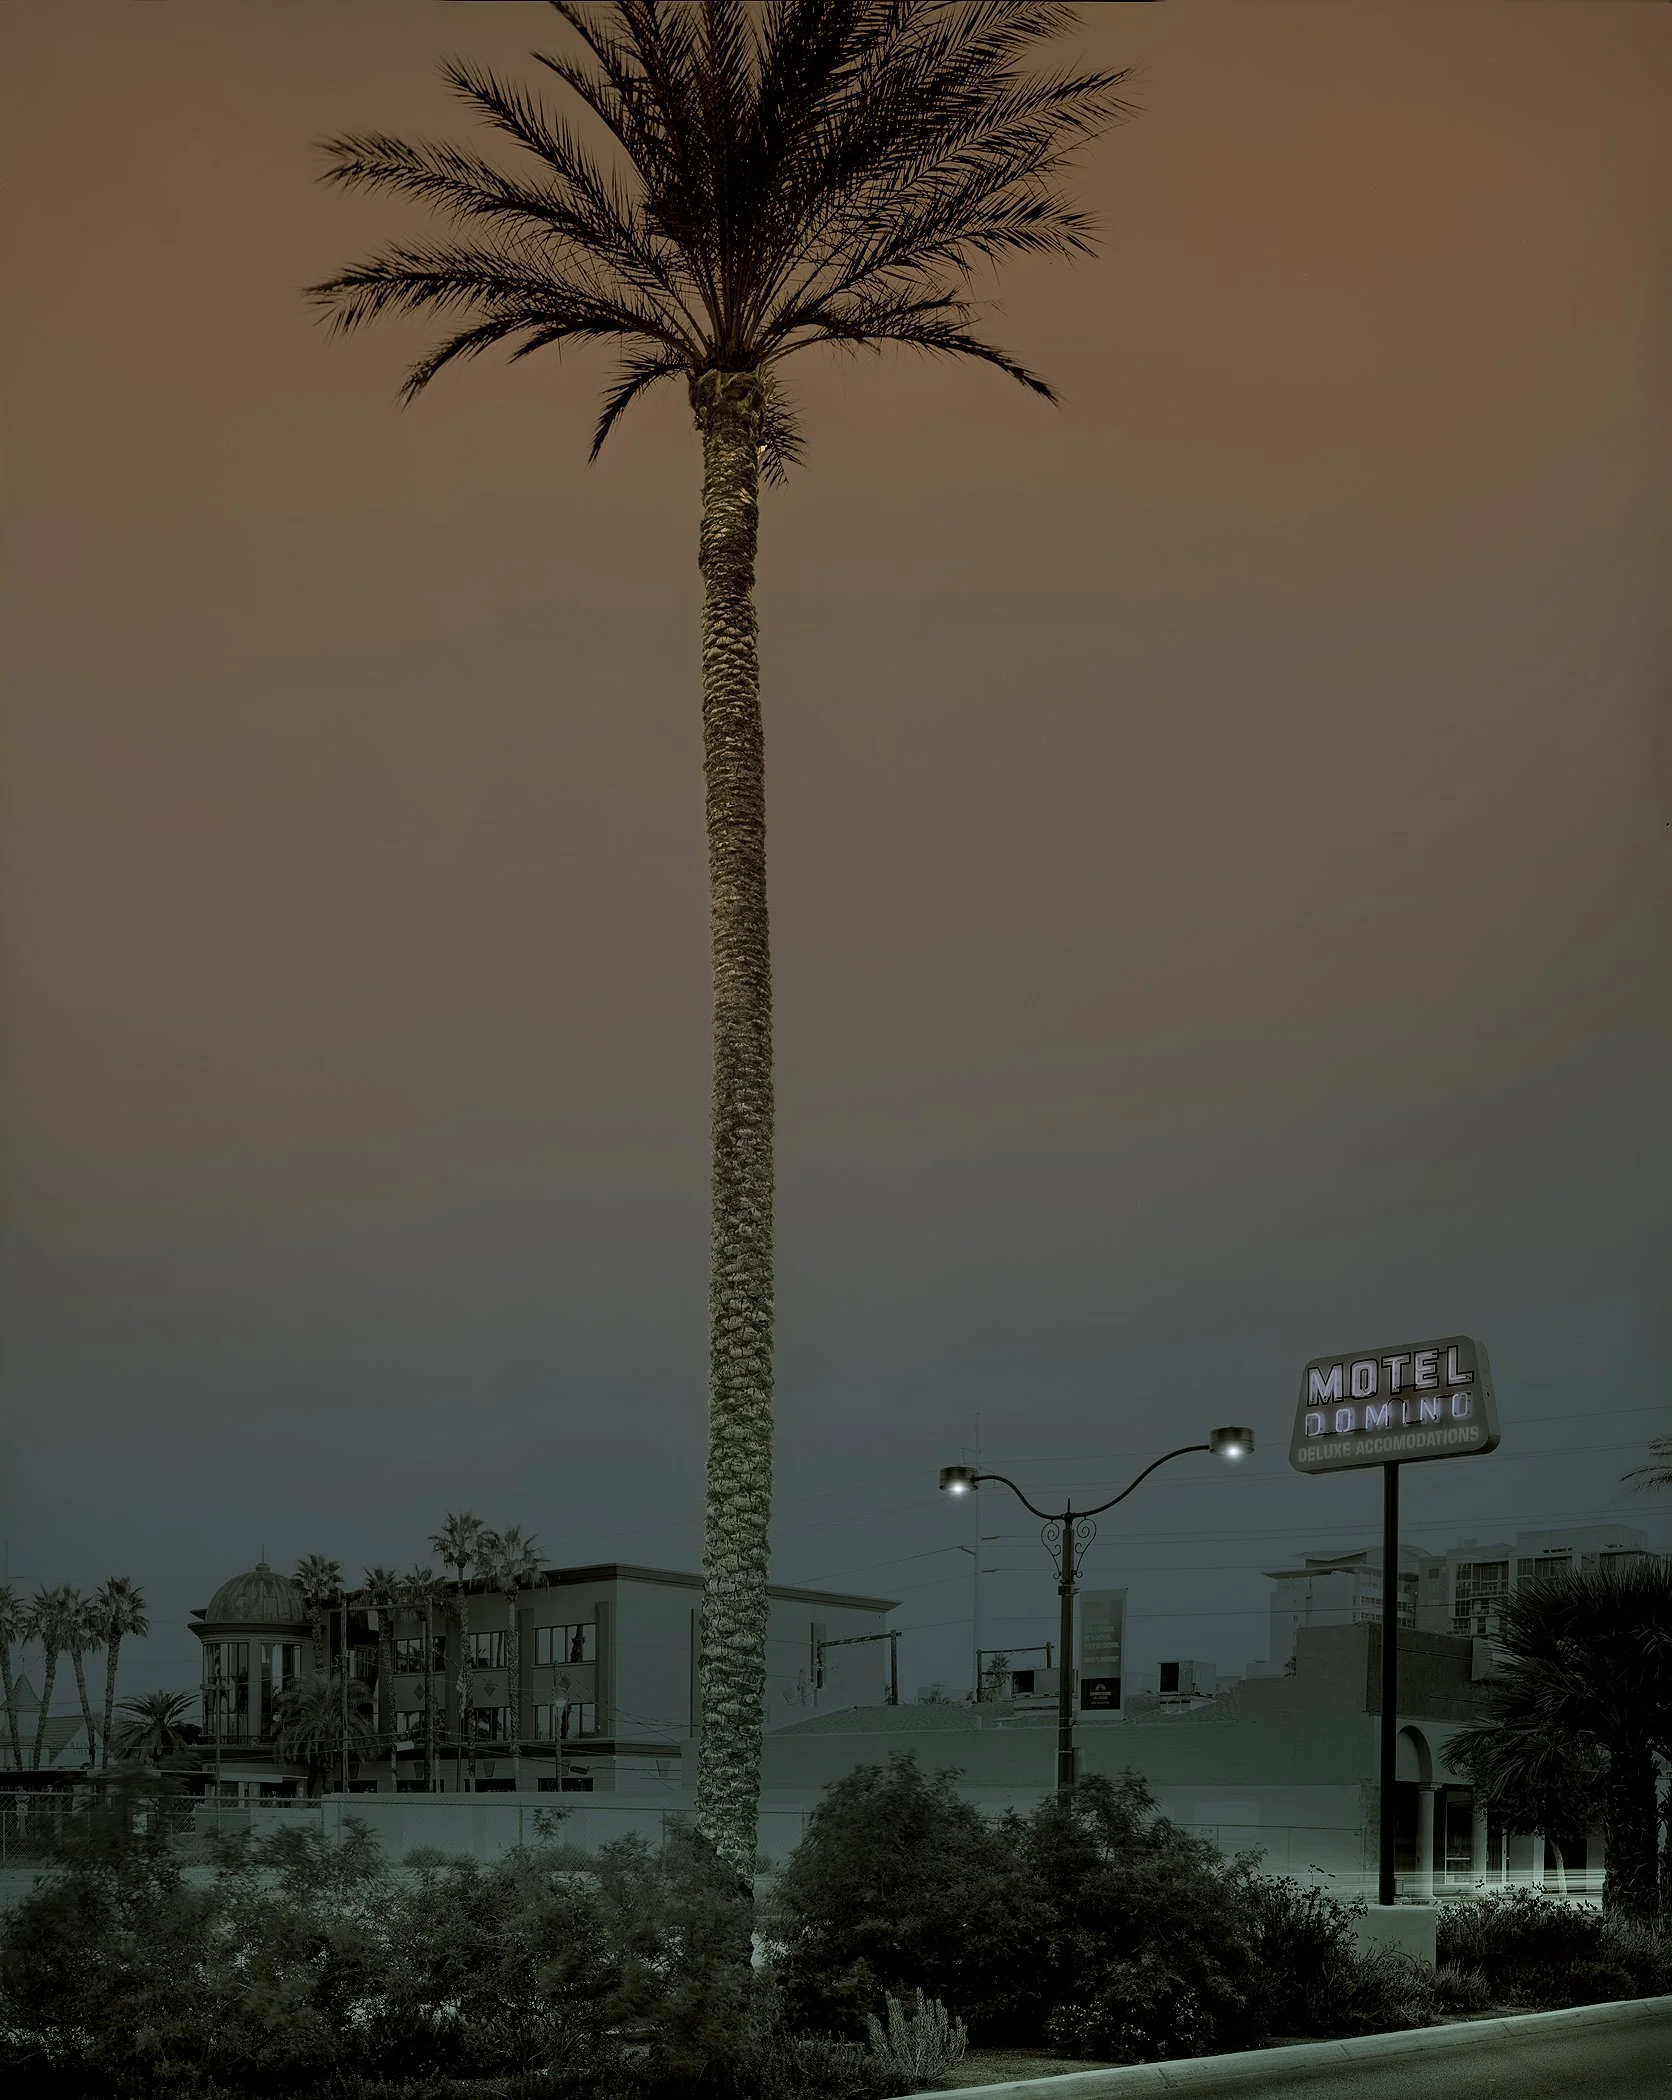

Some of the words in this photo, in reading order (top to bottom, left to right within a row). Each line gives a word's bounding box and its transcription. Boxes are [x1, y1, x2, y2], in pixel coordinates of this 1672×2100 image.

[1307, 1345, 1474, 1407] MOTEL
[1305, 1392, 1473, 1439] DOMINO
[1298, 1442, 1351, 1463] DELUXE
[1355, 1426, 1480, 1456] ACCOMODATIONS
